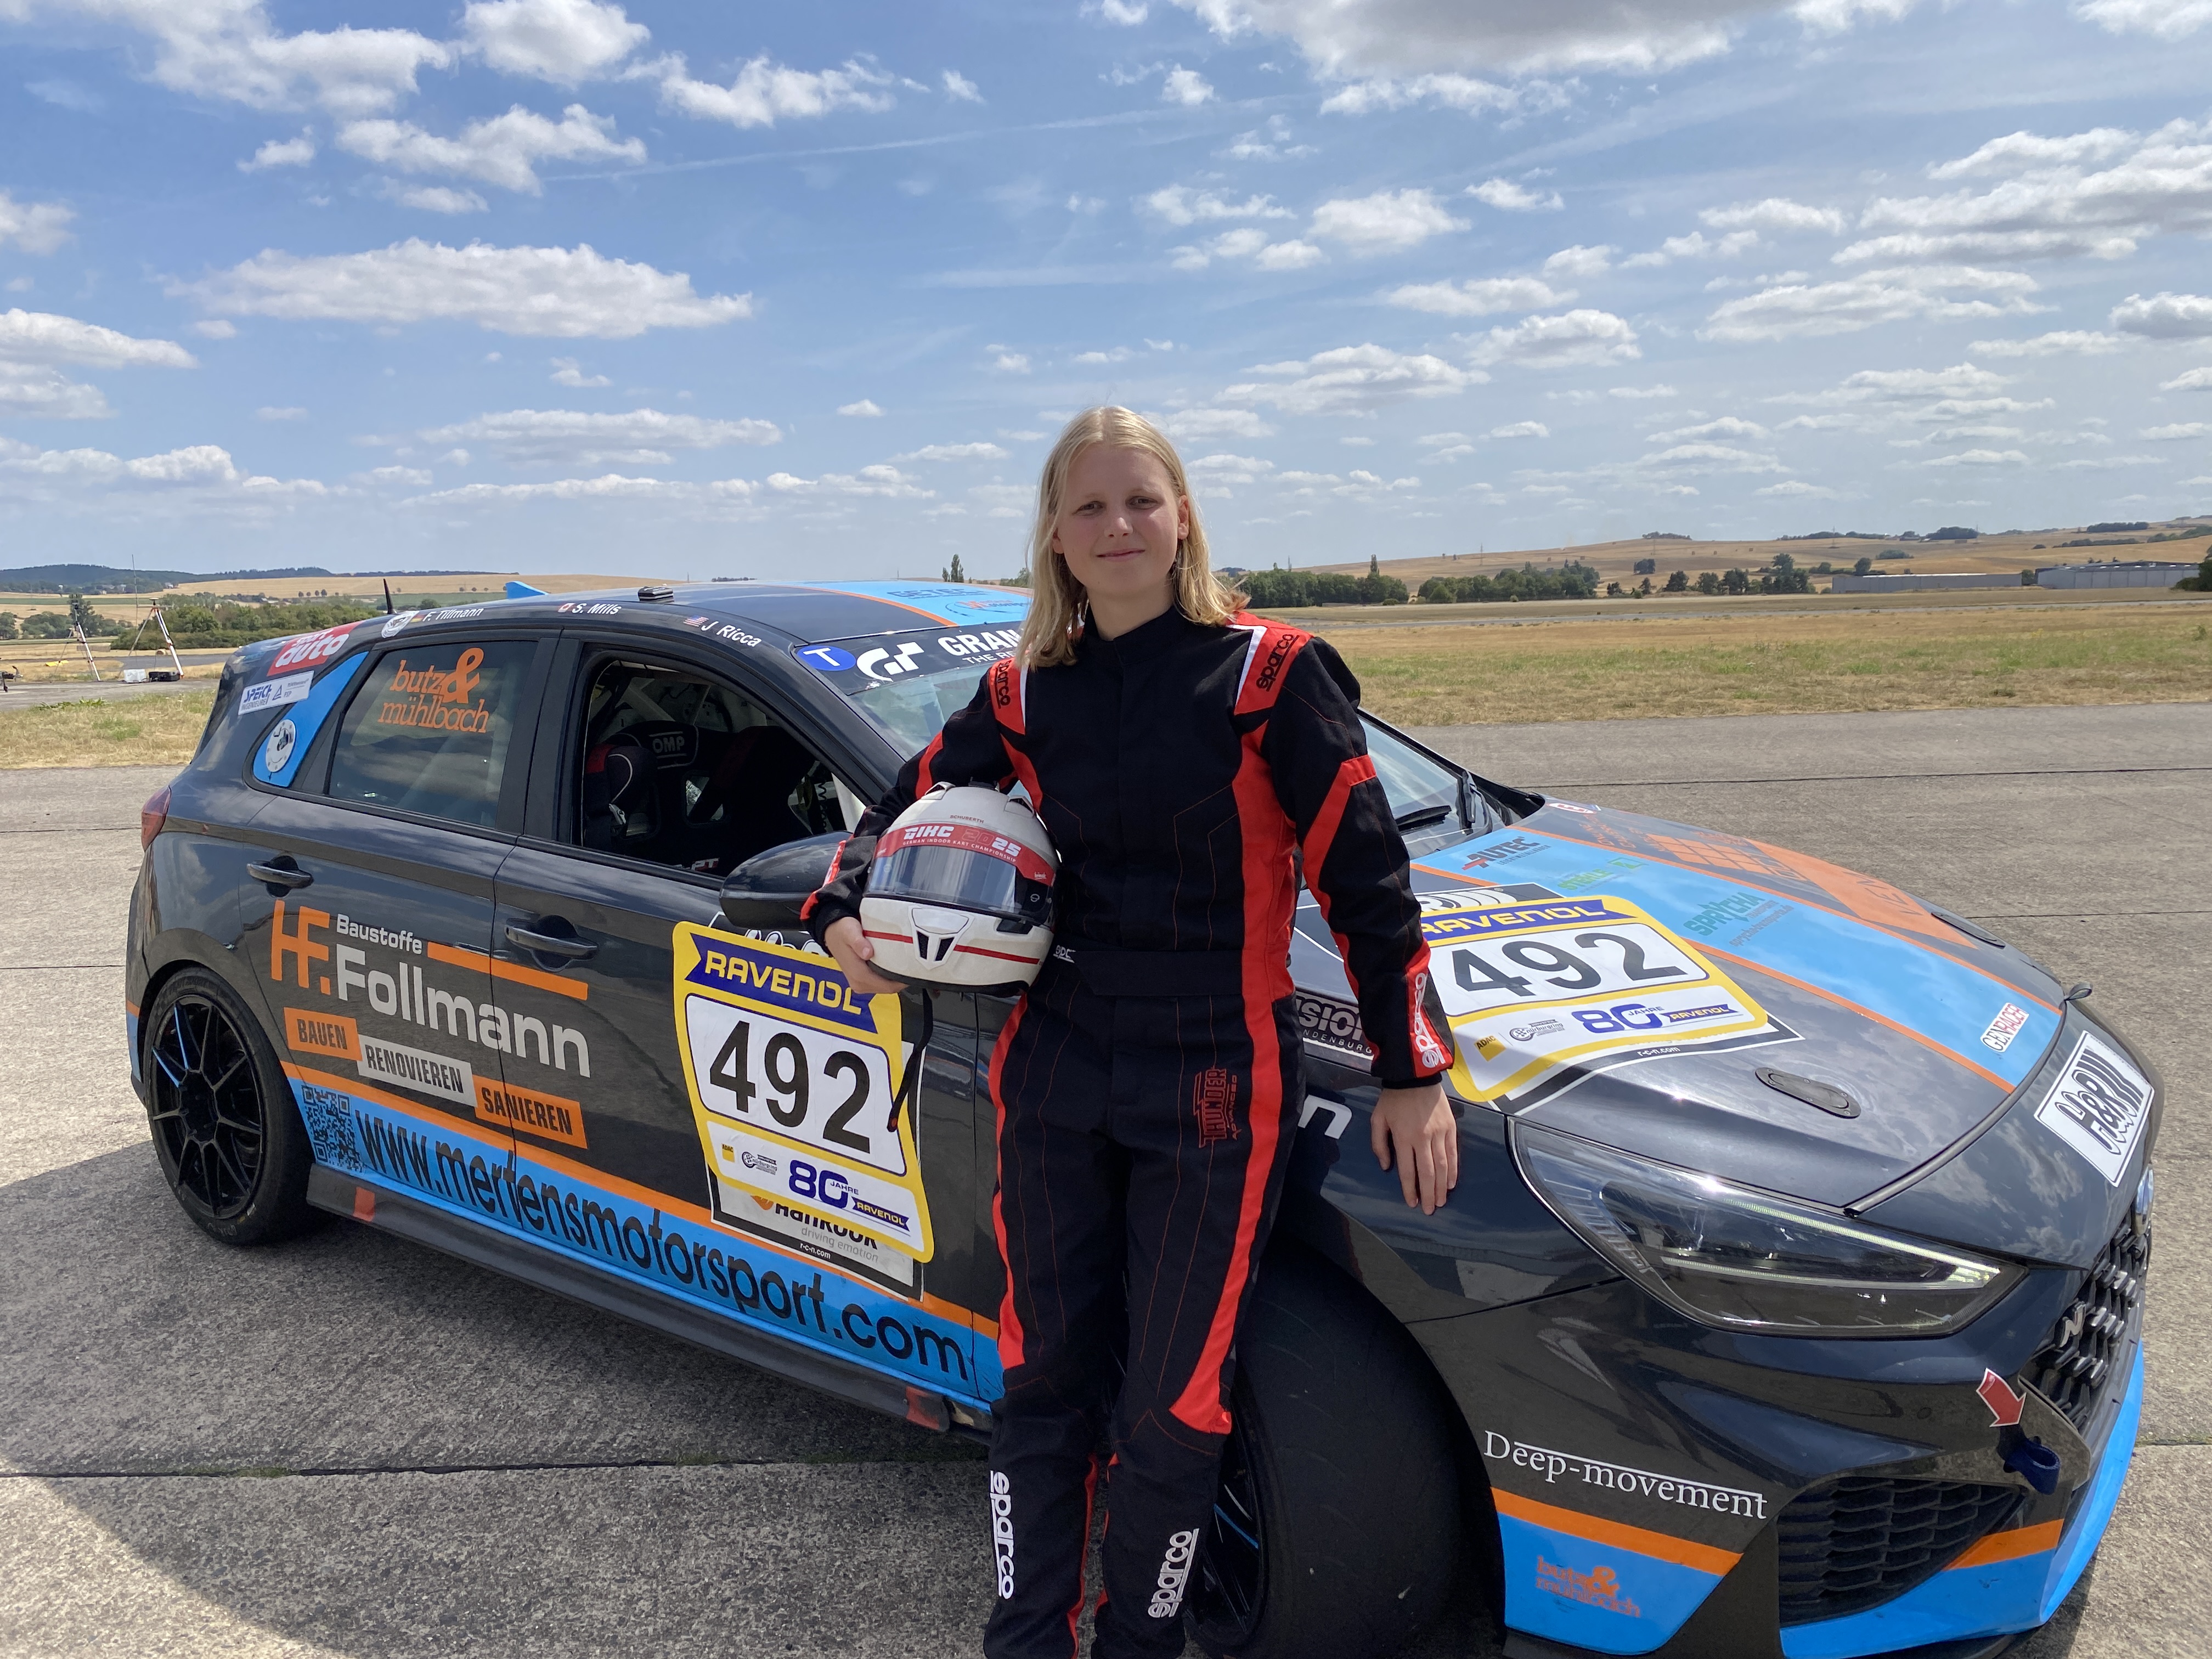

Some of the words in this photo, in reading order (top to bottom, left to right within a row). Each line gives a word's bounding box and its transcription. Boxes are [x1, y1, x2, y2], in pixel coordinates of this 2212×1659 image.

[422, 611, 437, 622] F.
[436, 608, 484, 620] Tillmann
[572, 602, 586, 614] S.
[587, 603, 622, 615] Mills
[275, 634, 349, 668] auto
[716, 624, 763, 648] Ricca
[803, 647, 841, 667] T
[962, 652, 995, 665] THE
[1256, 634, 1300, 692] sparco
[390, 659, 446, 695] butz
[440, 647, 484, 704] &
[994, 659, 1012, 709] sparco
[377, 693, 490, 733] mühlbach
[652, 736, 685, 754] OMP
[903, 825, 955, 840] GIKC
[950, 815, 985, 823] SCHUBERTH
[971, 844, 1017, 864] CHAMPIONSHIP
[1462, 837, 1541, 870] AUTEC
[336, 913, 422, 955] Baustoffe
[1452, 933, 1688, 997] 492
[705, 950, 862, 1015] RAVENOL
[336, 943, 591, 1079] Follmann
[1571, 1003, 1663, 1033] 80
[1627, 1006, 1664, 1016] JAHRE
[1669, 1006, 1730, 1020] RAVENOL
[297, 1018, 348, 1051] BAUEN
[1476, 1035, 1497, 1050] ADAC
[1637, 1046, 1681, 1057] r-c-n.com
[366, 1043, 465, 1094] RENOVIEREN
[709, 1020, 871, 1154] 492
[1204, 1068, 1228, 1139] THUNDER
[482, 1086, 573, 1137] SANIEREN
[721, 1143, 734, 1153] ADAC
[789, 1160, 849, 1209] 80
[830, 1181, 860, 1195] JAHRE
[856, 1201, 906, 1226] RAVENOL
[354, 1109, 969, 1381] www.mertensmotorsport.com
[799, 1242, 831, 1260] r-c-n.com
[801, 1227, 834, 1249] driving
[837, 1241, 879, 1262] emotion
[1484, 1430, 1768, 1520] Deep-movement
[990, 1470, 1014, 1600] sparco
[1148, 1528, 1200, 1618] sparco
